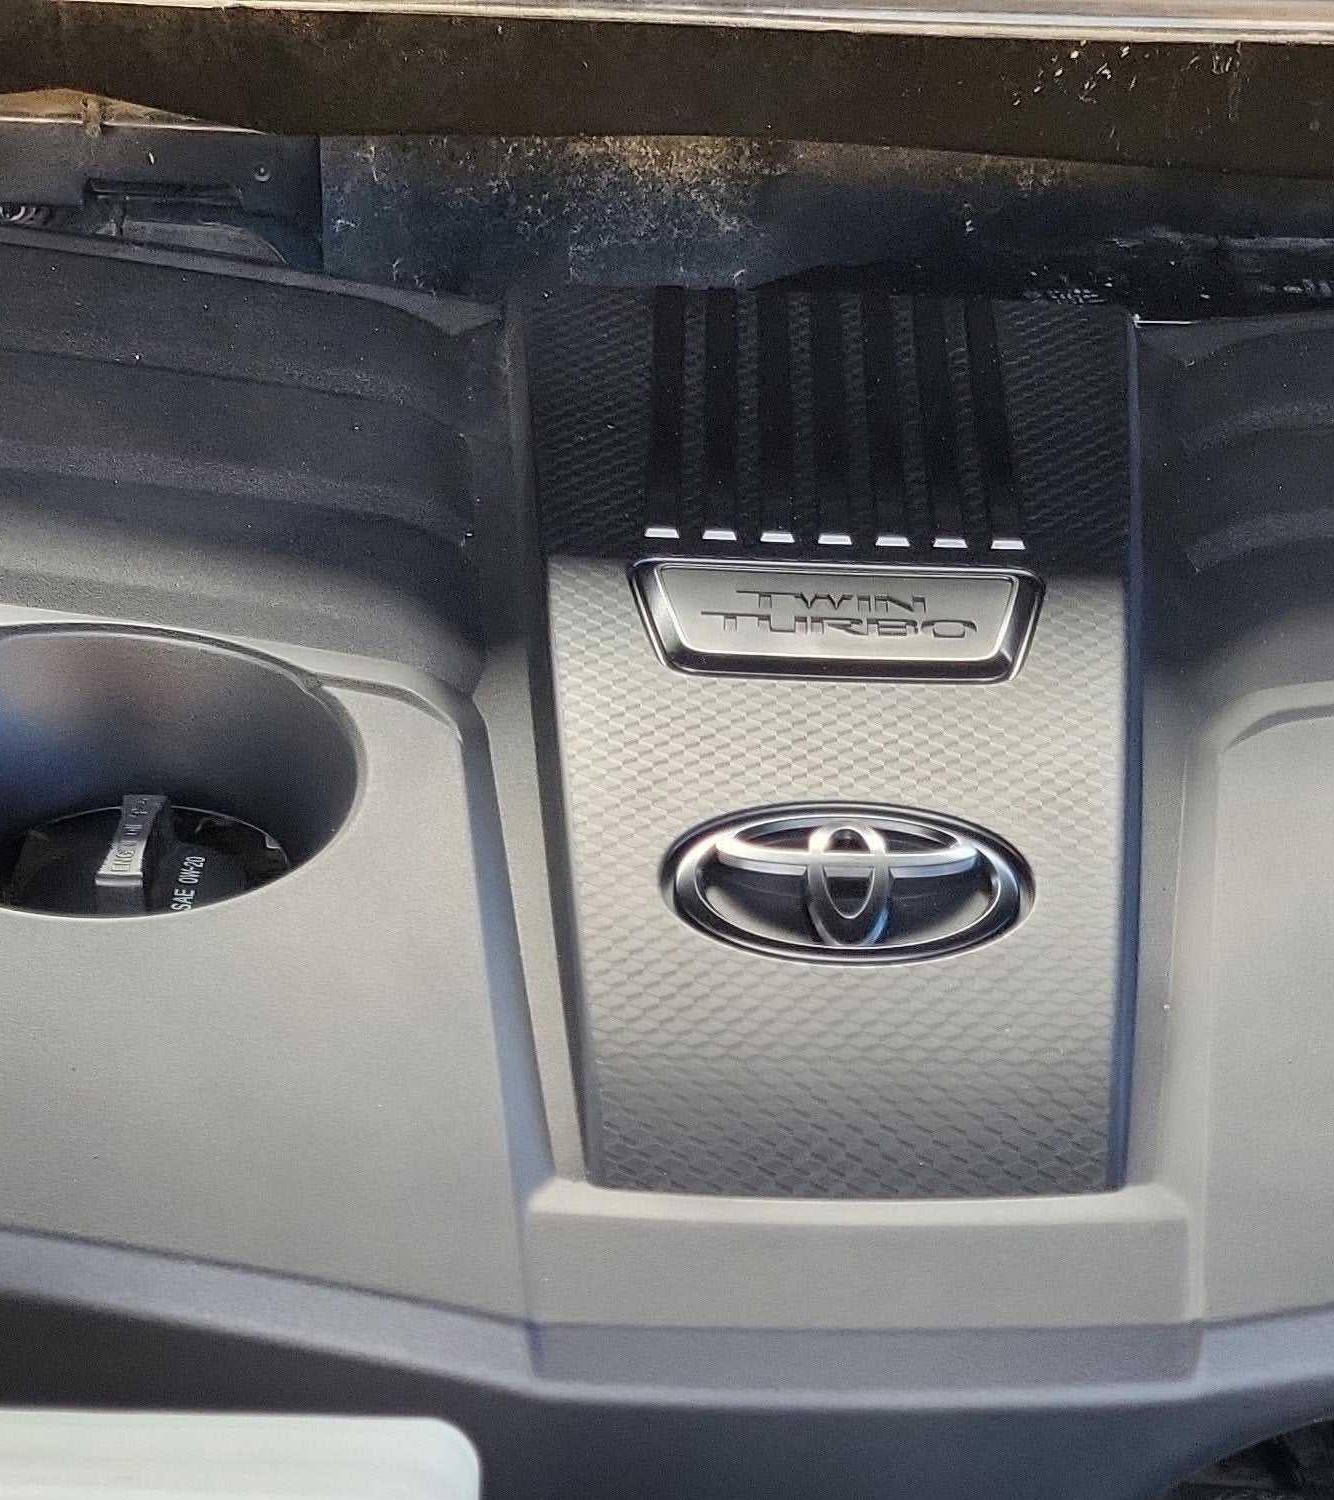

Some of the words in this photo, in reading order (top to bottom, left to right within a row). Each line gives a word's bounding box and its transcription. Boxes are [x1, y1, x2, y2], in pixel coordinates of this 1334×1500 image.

[735, 589, 928, 613] TWIN
[701, 611, 978, 638] TURBO
[178, 856, 206, 884] 0W-20
[170, 888, 196, 911] SAE
